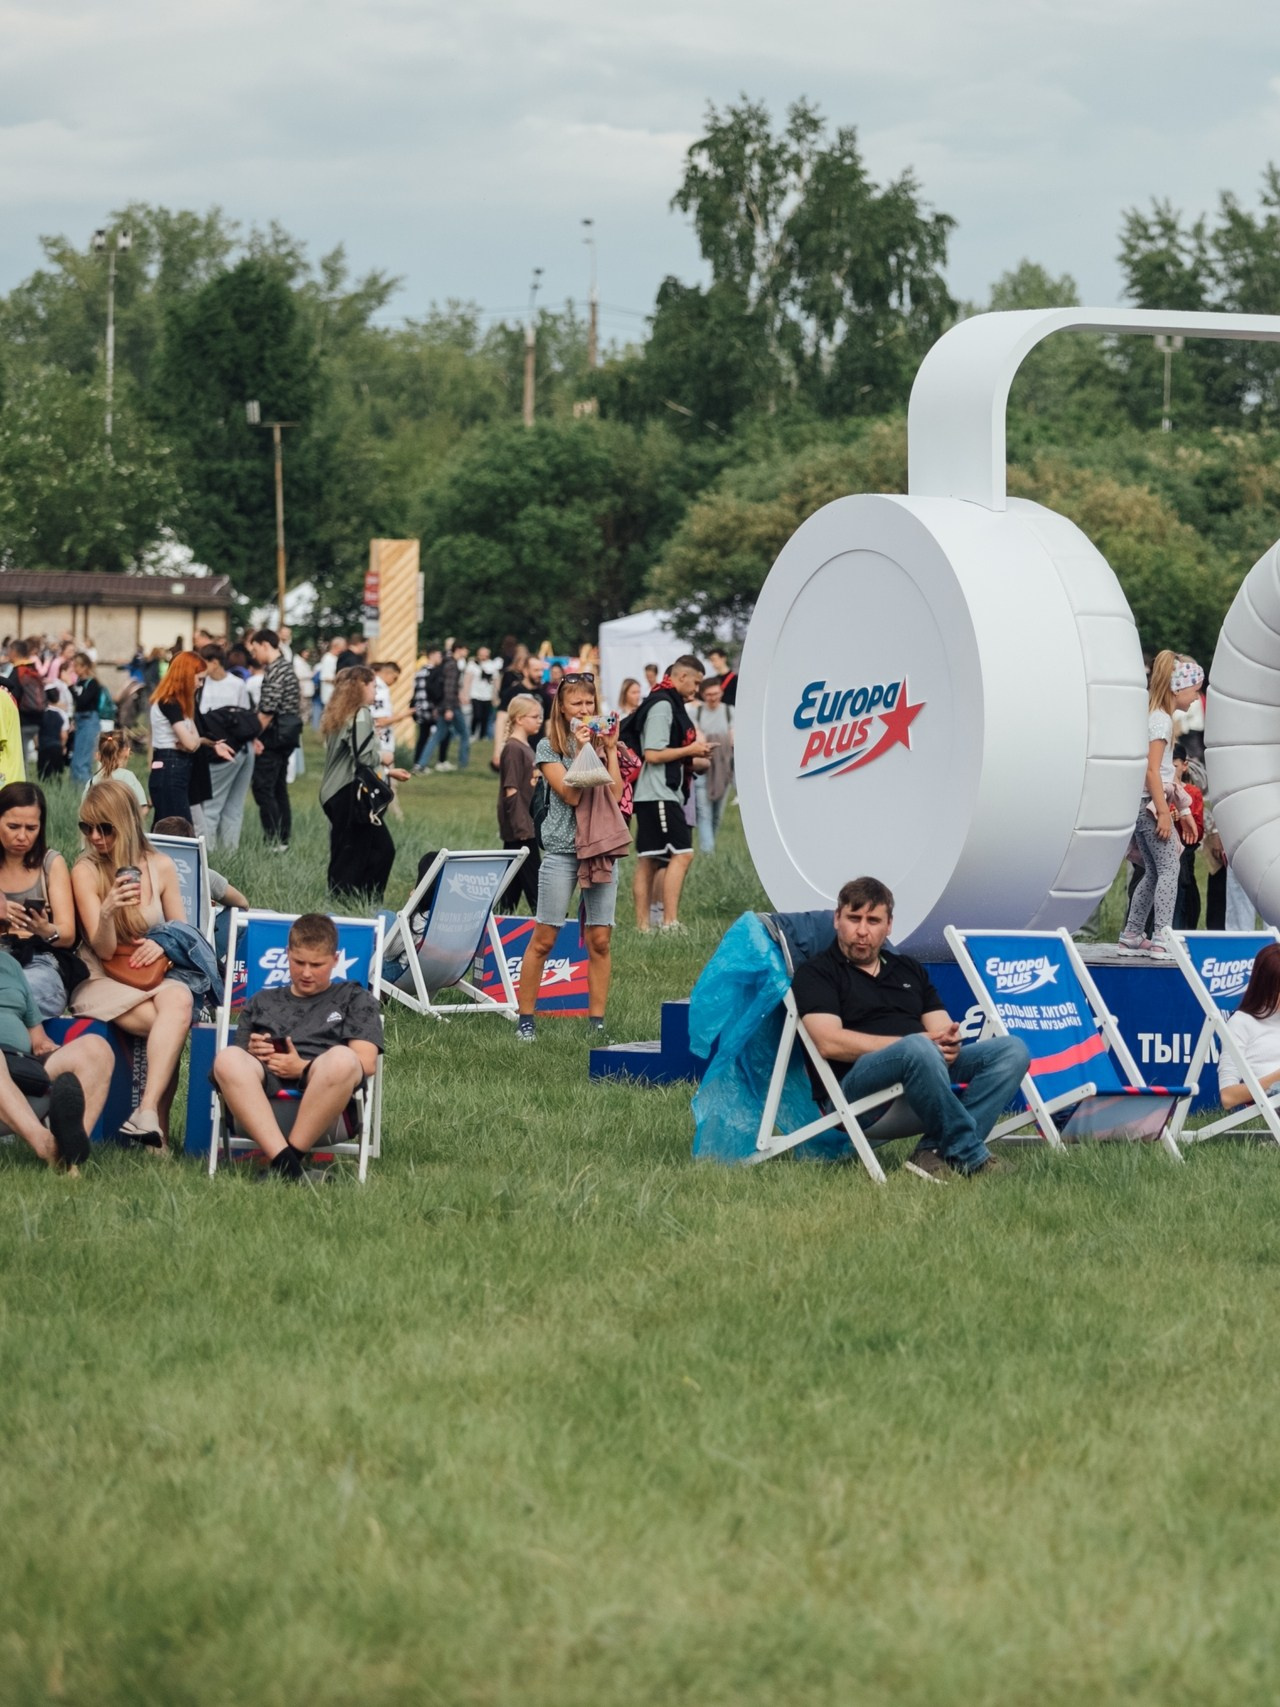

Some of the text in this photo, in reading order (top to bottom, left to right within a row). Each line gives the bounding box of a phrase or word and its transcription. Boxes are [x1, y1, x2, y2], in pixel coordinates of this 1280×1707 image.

[793, 680, 901, 730] Europa
[986, 957, 1044, 976] Europa
[995, 1001, 1078, 1018] БОЛЬШЕ ХИТОВ!
[1040, 1016, 1082, 1030] МУЗЫКИ!
[1137, 1032, 1192, 1064] ТЫ!
